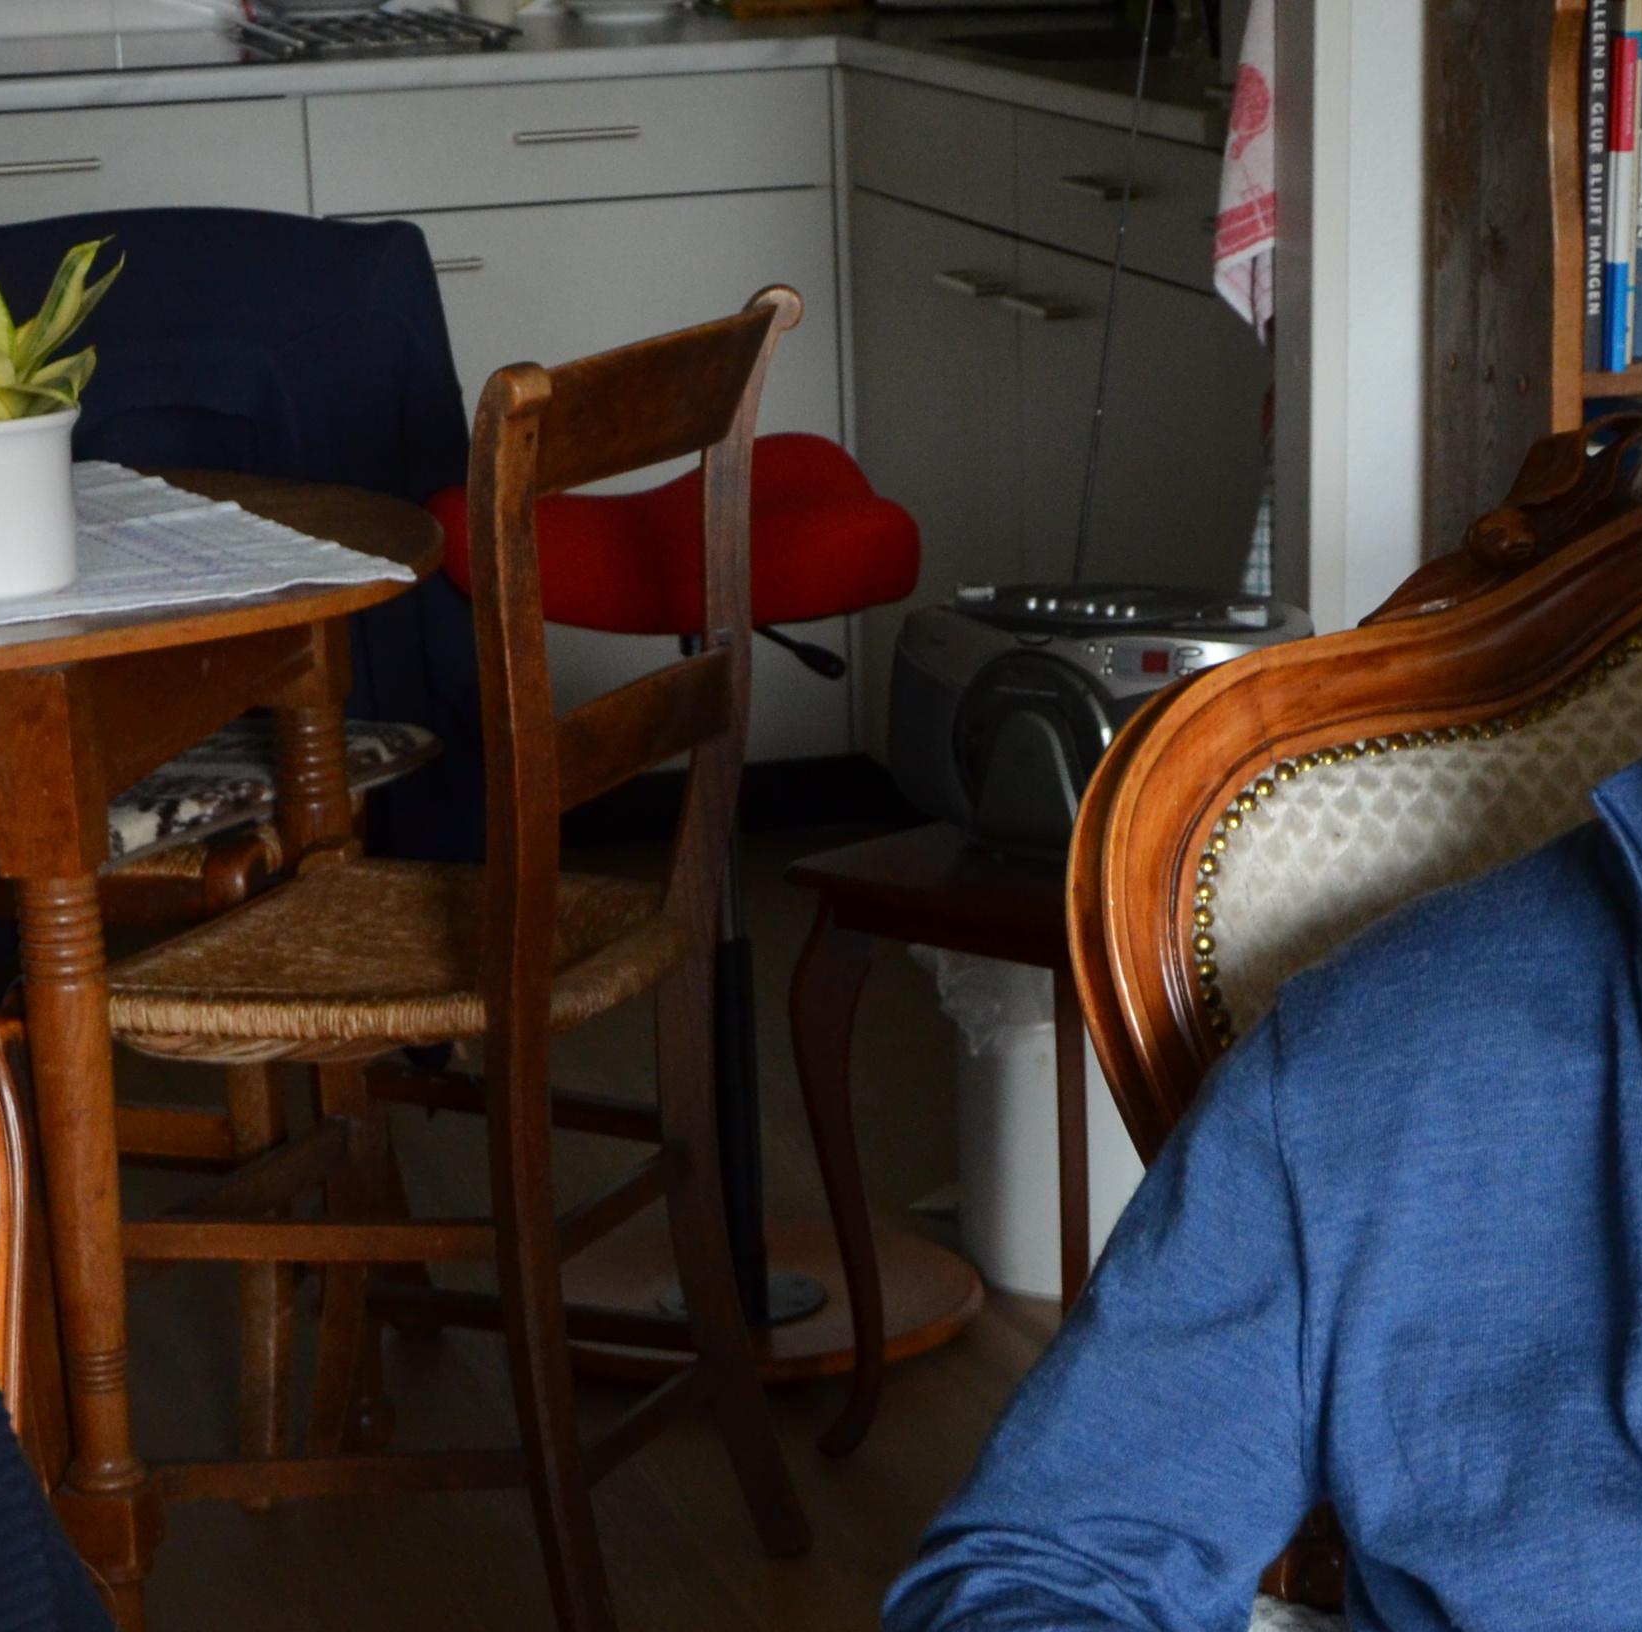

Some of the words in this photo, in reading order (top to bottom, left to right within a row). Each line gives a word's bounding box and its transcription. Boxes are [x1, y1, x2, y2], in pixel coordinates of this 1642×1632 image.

[1590, 67, 1605, 92] DE
[1588, 101, 1604, 154] GEUR
[1588, 163, 1604, 225] BLIJFT
[1587, 234, 1602, 315] HANGEN
